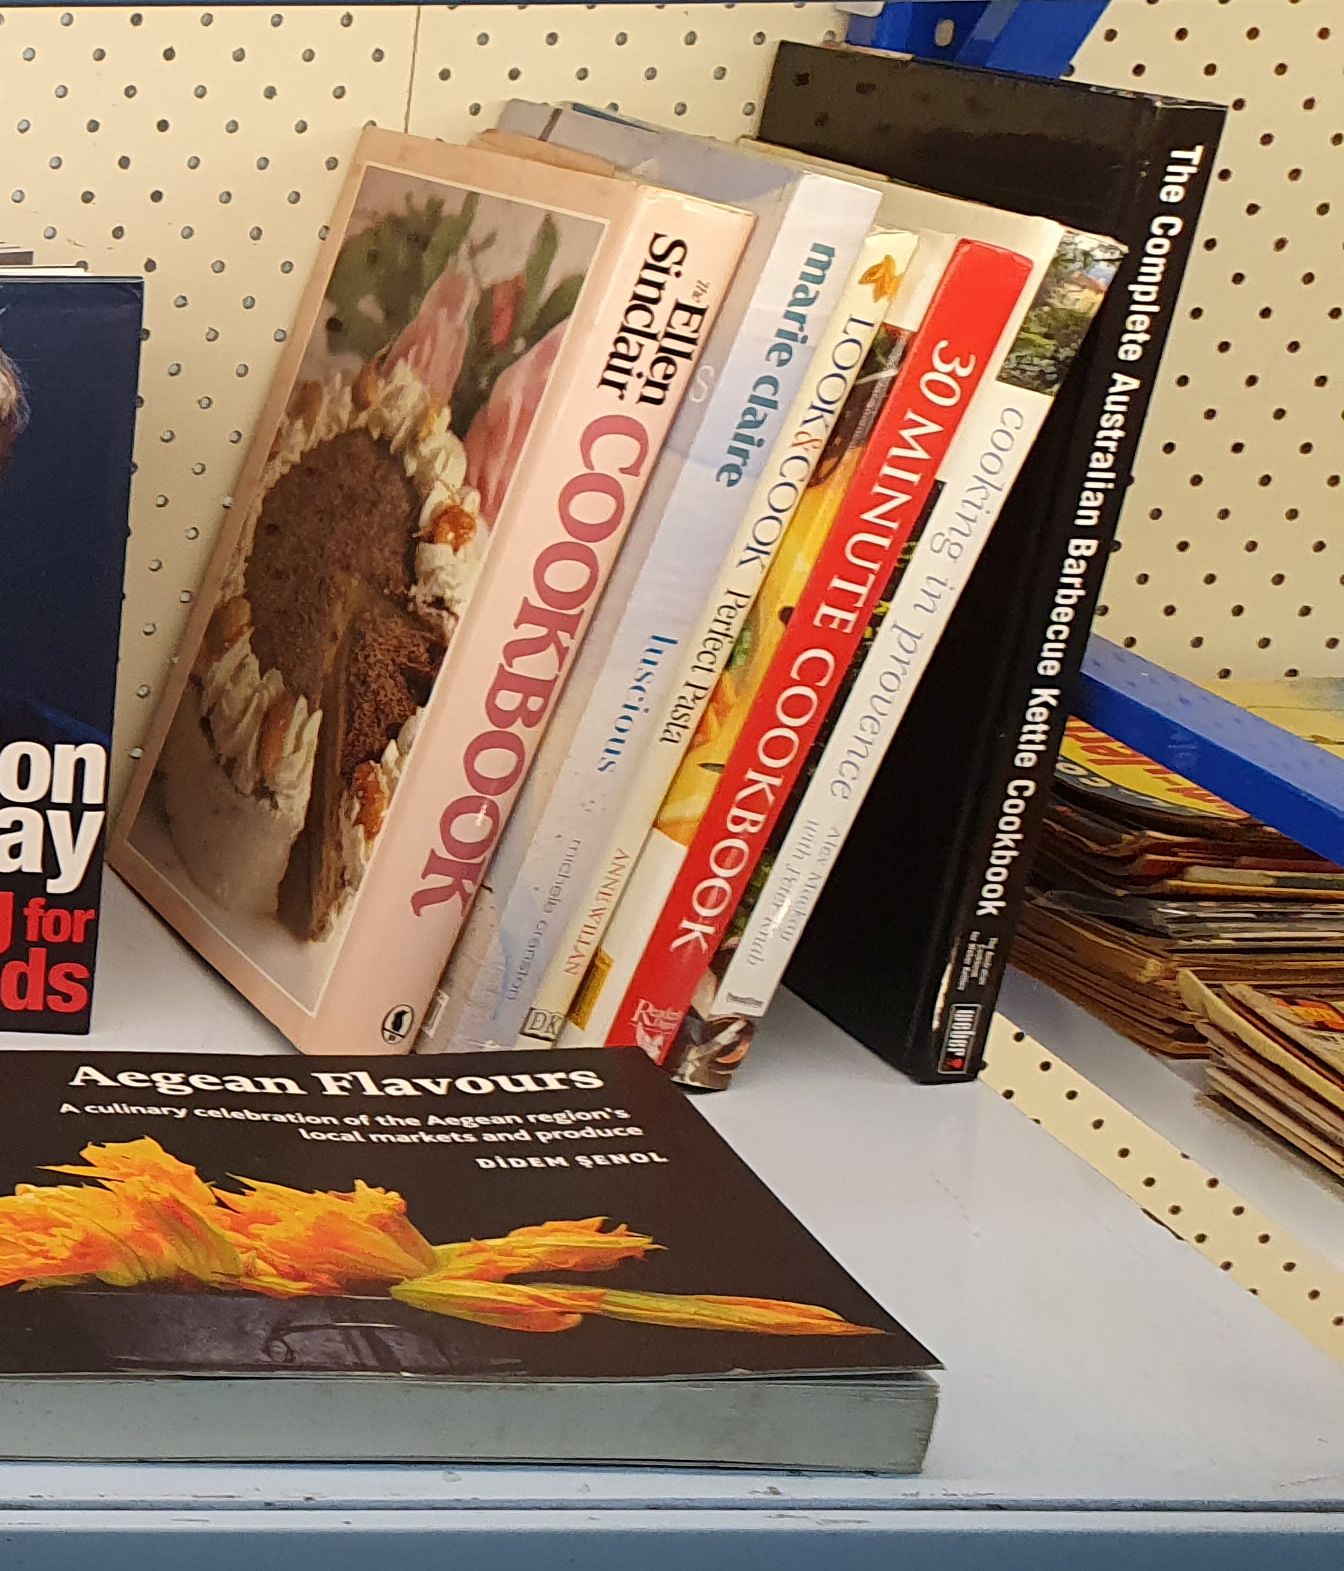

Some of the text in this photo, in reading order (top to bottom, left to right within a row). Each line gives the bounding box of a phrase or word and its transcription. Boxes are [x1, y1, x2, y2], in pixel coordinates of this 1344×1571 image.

[1159, 144, 1205, 204] The
[597, 232, 688, 401] Sinclair
[636, 299, 709, 407] Ellen
[1117, 214, 1184, 363] Complete
[715, 243, 836, 489] marie claire
[919, 340, 976, 407] 30
[1072, 371, 1141, 527] Australian
[815, 421, 944, 634] MINUTE
[410, 414, 649, 917] COOKBOOK
[659, 588, 753, 745] Perfect Pasta
[830, 406, 1026, 801] cooking in provence
[1036, 538, 1098, 678] Barbecue
[598, 633, 678, 773] luscious
[1015, 687, 1062, 770] Kettle
[670, 647, 836, 955] COOKBOOK
[976, 778, 1036, 917] Cookbook
[24, 898, 96, 943] for
[599, 848, 631, 899] ANNE
[59, 1102, 631, 1129] A culinary celebration of the Aegean region's
[68, 1065, 604, 1096] Aegean Flavours
[299, 1124, 645, 1144] local markets and produce
[574, 1151, 670, 1169] ŞENOL
